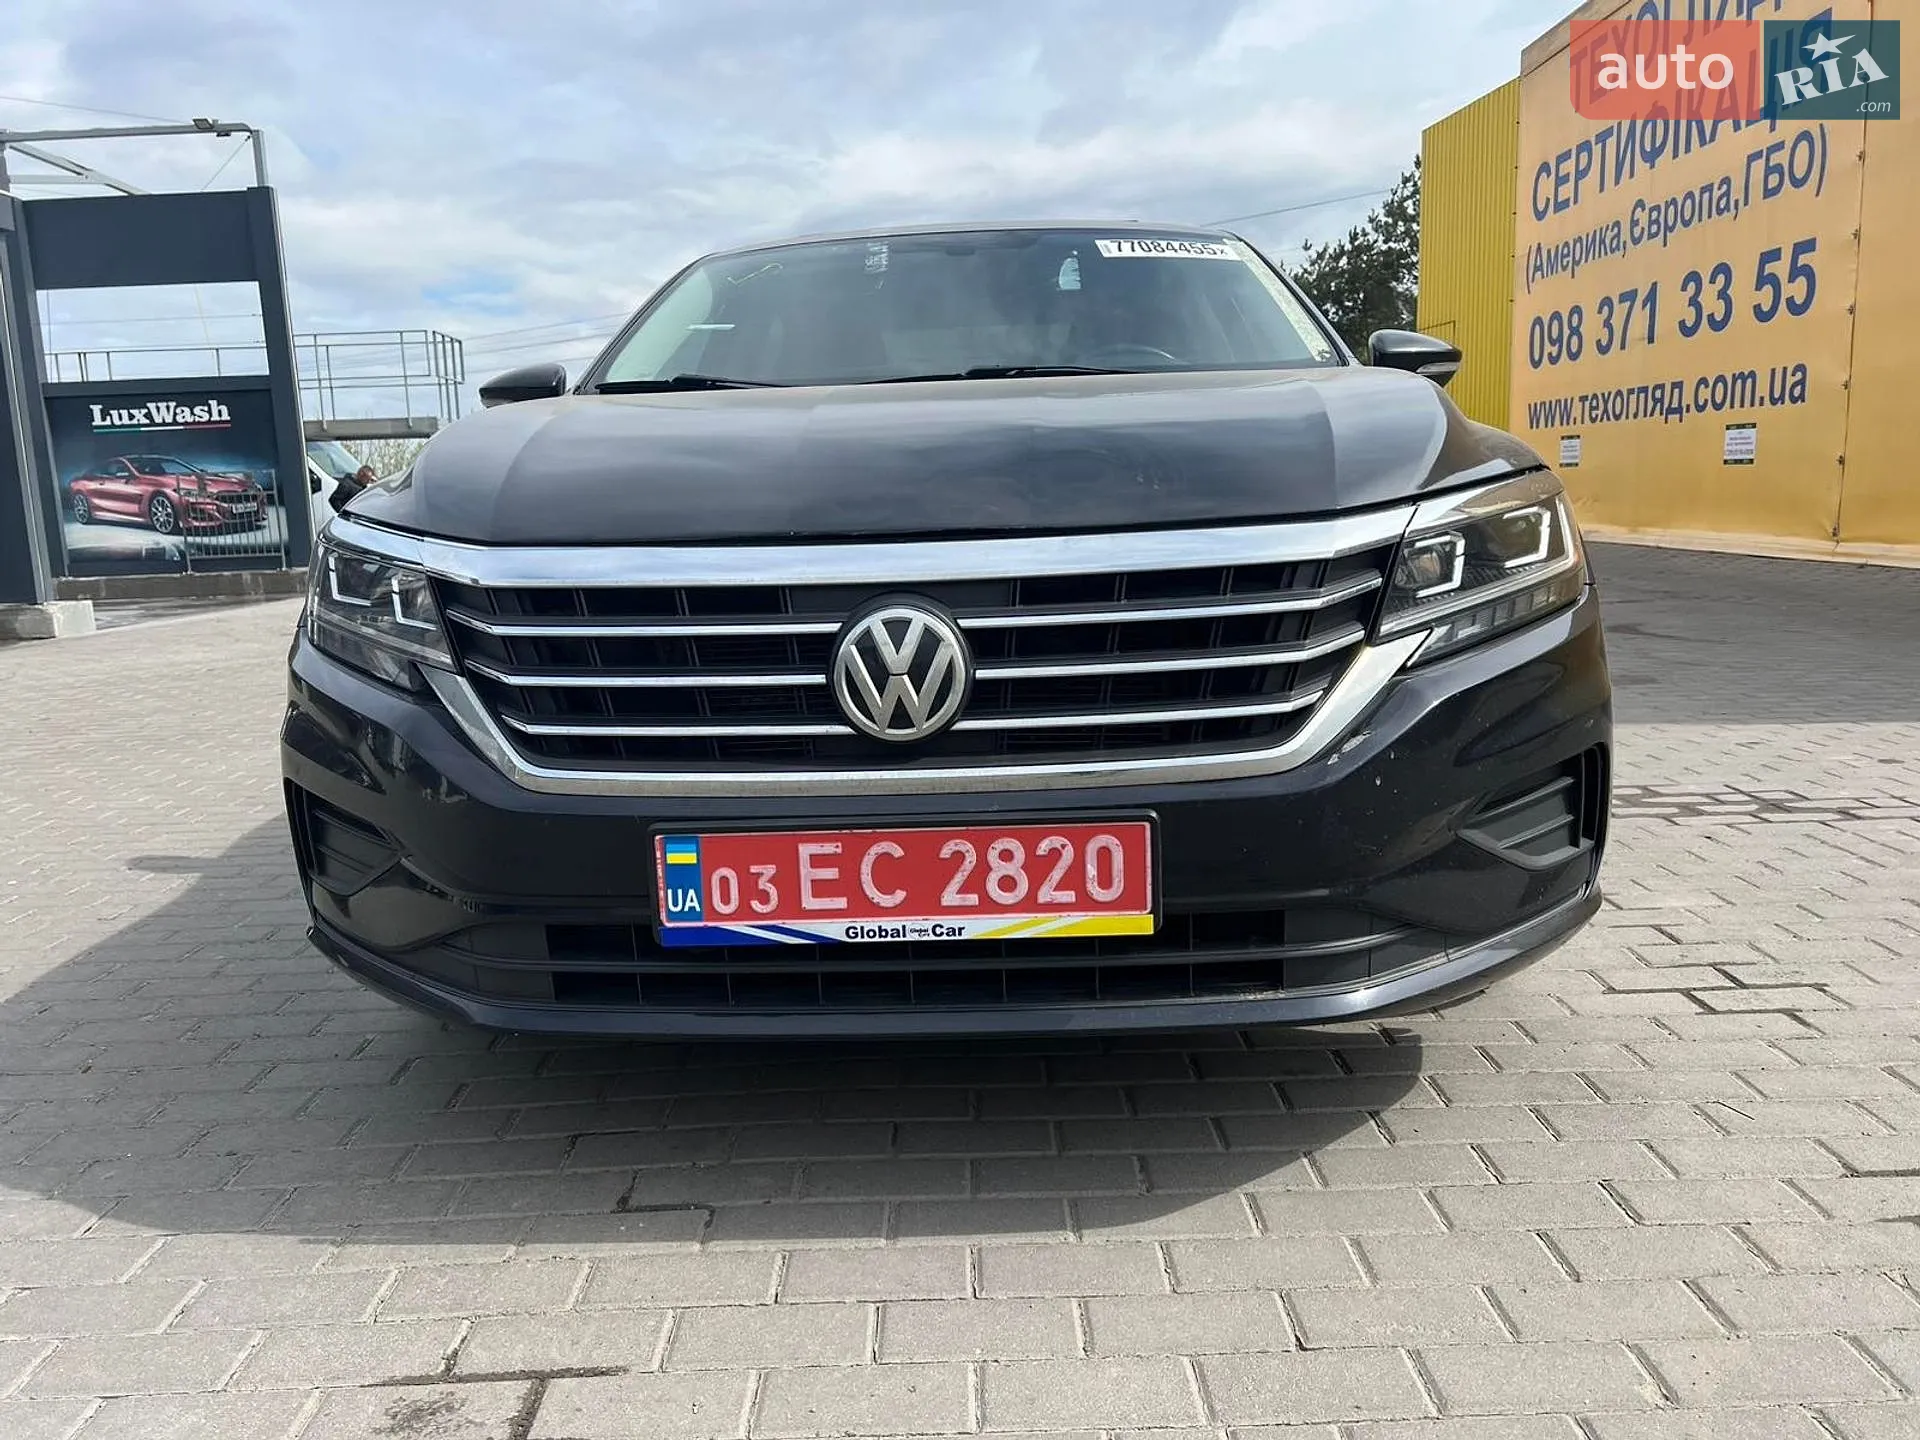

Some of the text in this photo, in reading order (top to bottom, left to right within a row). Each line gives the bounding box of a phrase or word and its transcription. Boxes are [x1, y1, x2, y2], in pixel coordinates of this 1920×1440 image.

[1529, 237, 1817, 370] 098 371 33 55
[90, 400, 231, 426] LuxWash
[1527, 362, 1808, 430] www.техогляд.com.ua
[710, 835, 1125, 915] 03 EC 2820
[667, 888, 700, 913] UA
[845, 923, 966, 939] Global Car
